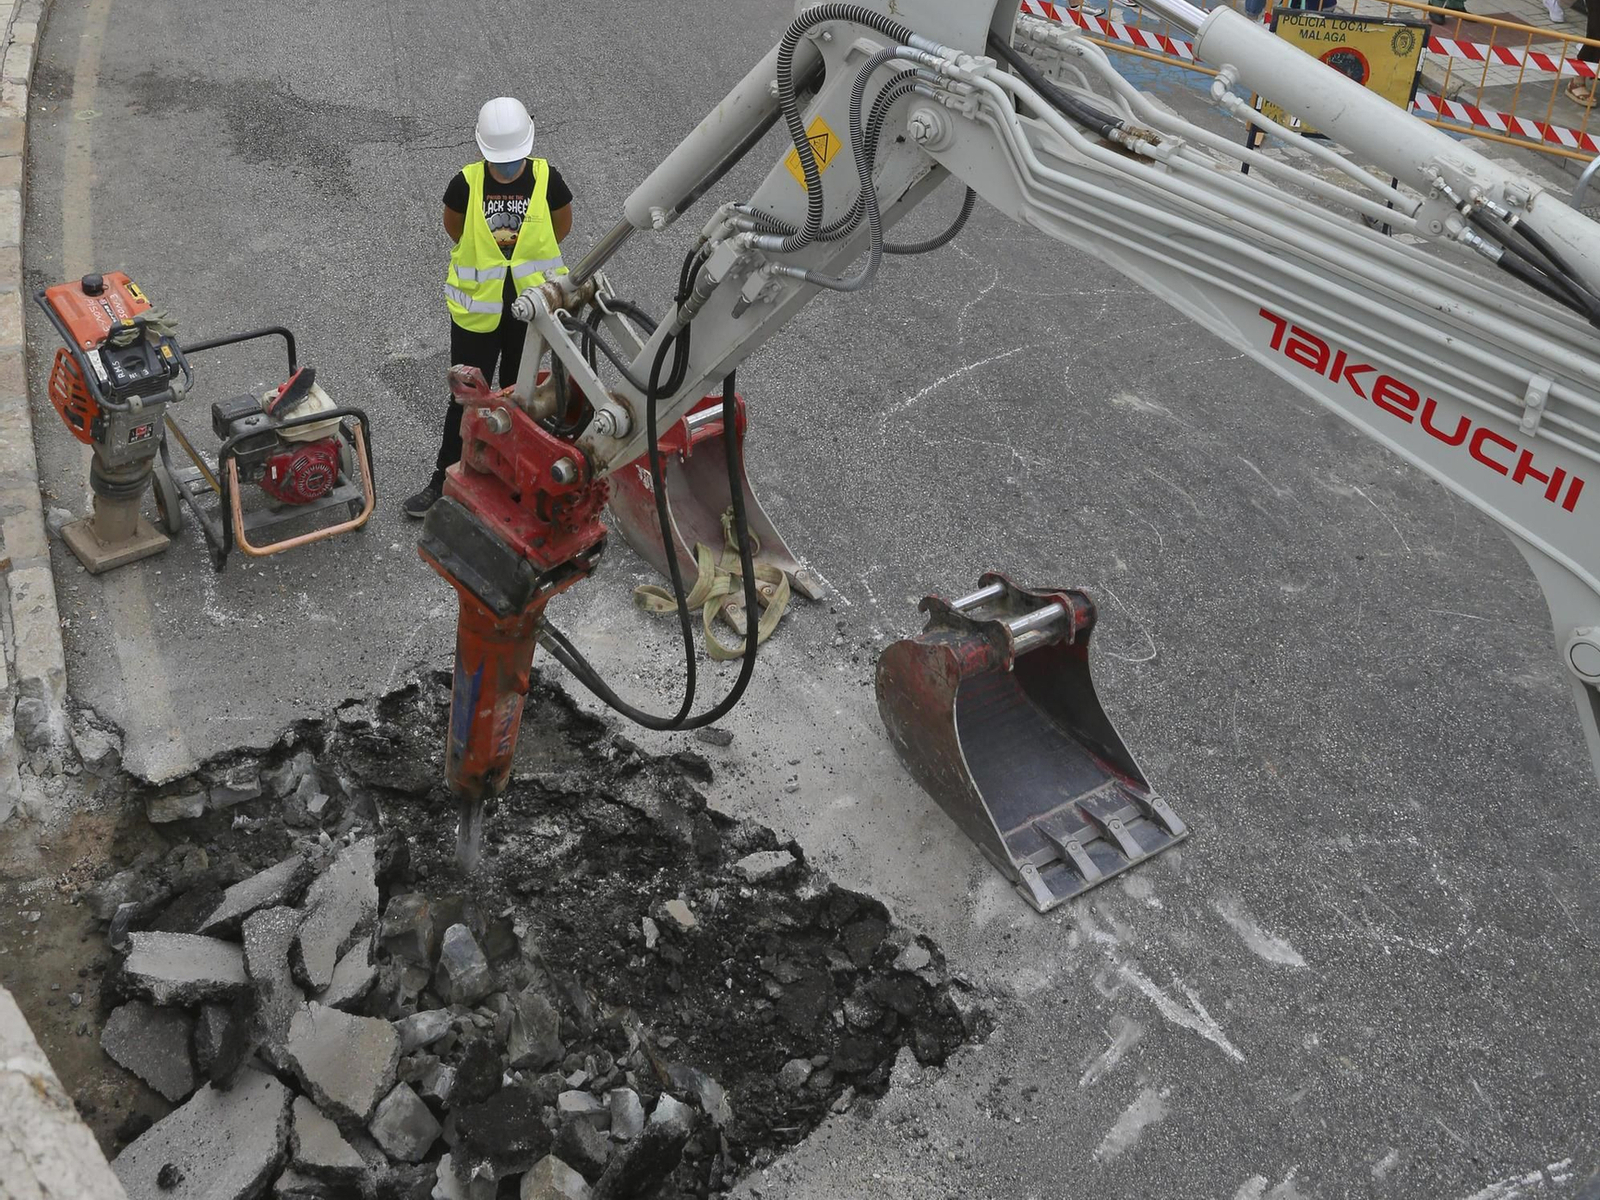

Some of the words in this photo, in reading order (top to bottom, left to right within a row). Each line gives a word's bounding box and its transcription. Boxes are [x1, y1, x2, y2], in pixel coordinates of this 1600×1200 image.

[1282, 14, 1326, 29] POLICIA
[1332, 20, 1370, 34] LOCAL
[1299, 29, 1347, 43] MALAGA
[483, 199, 504, 216] LACK
